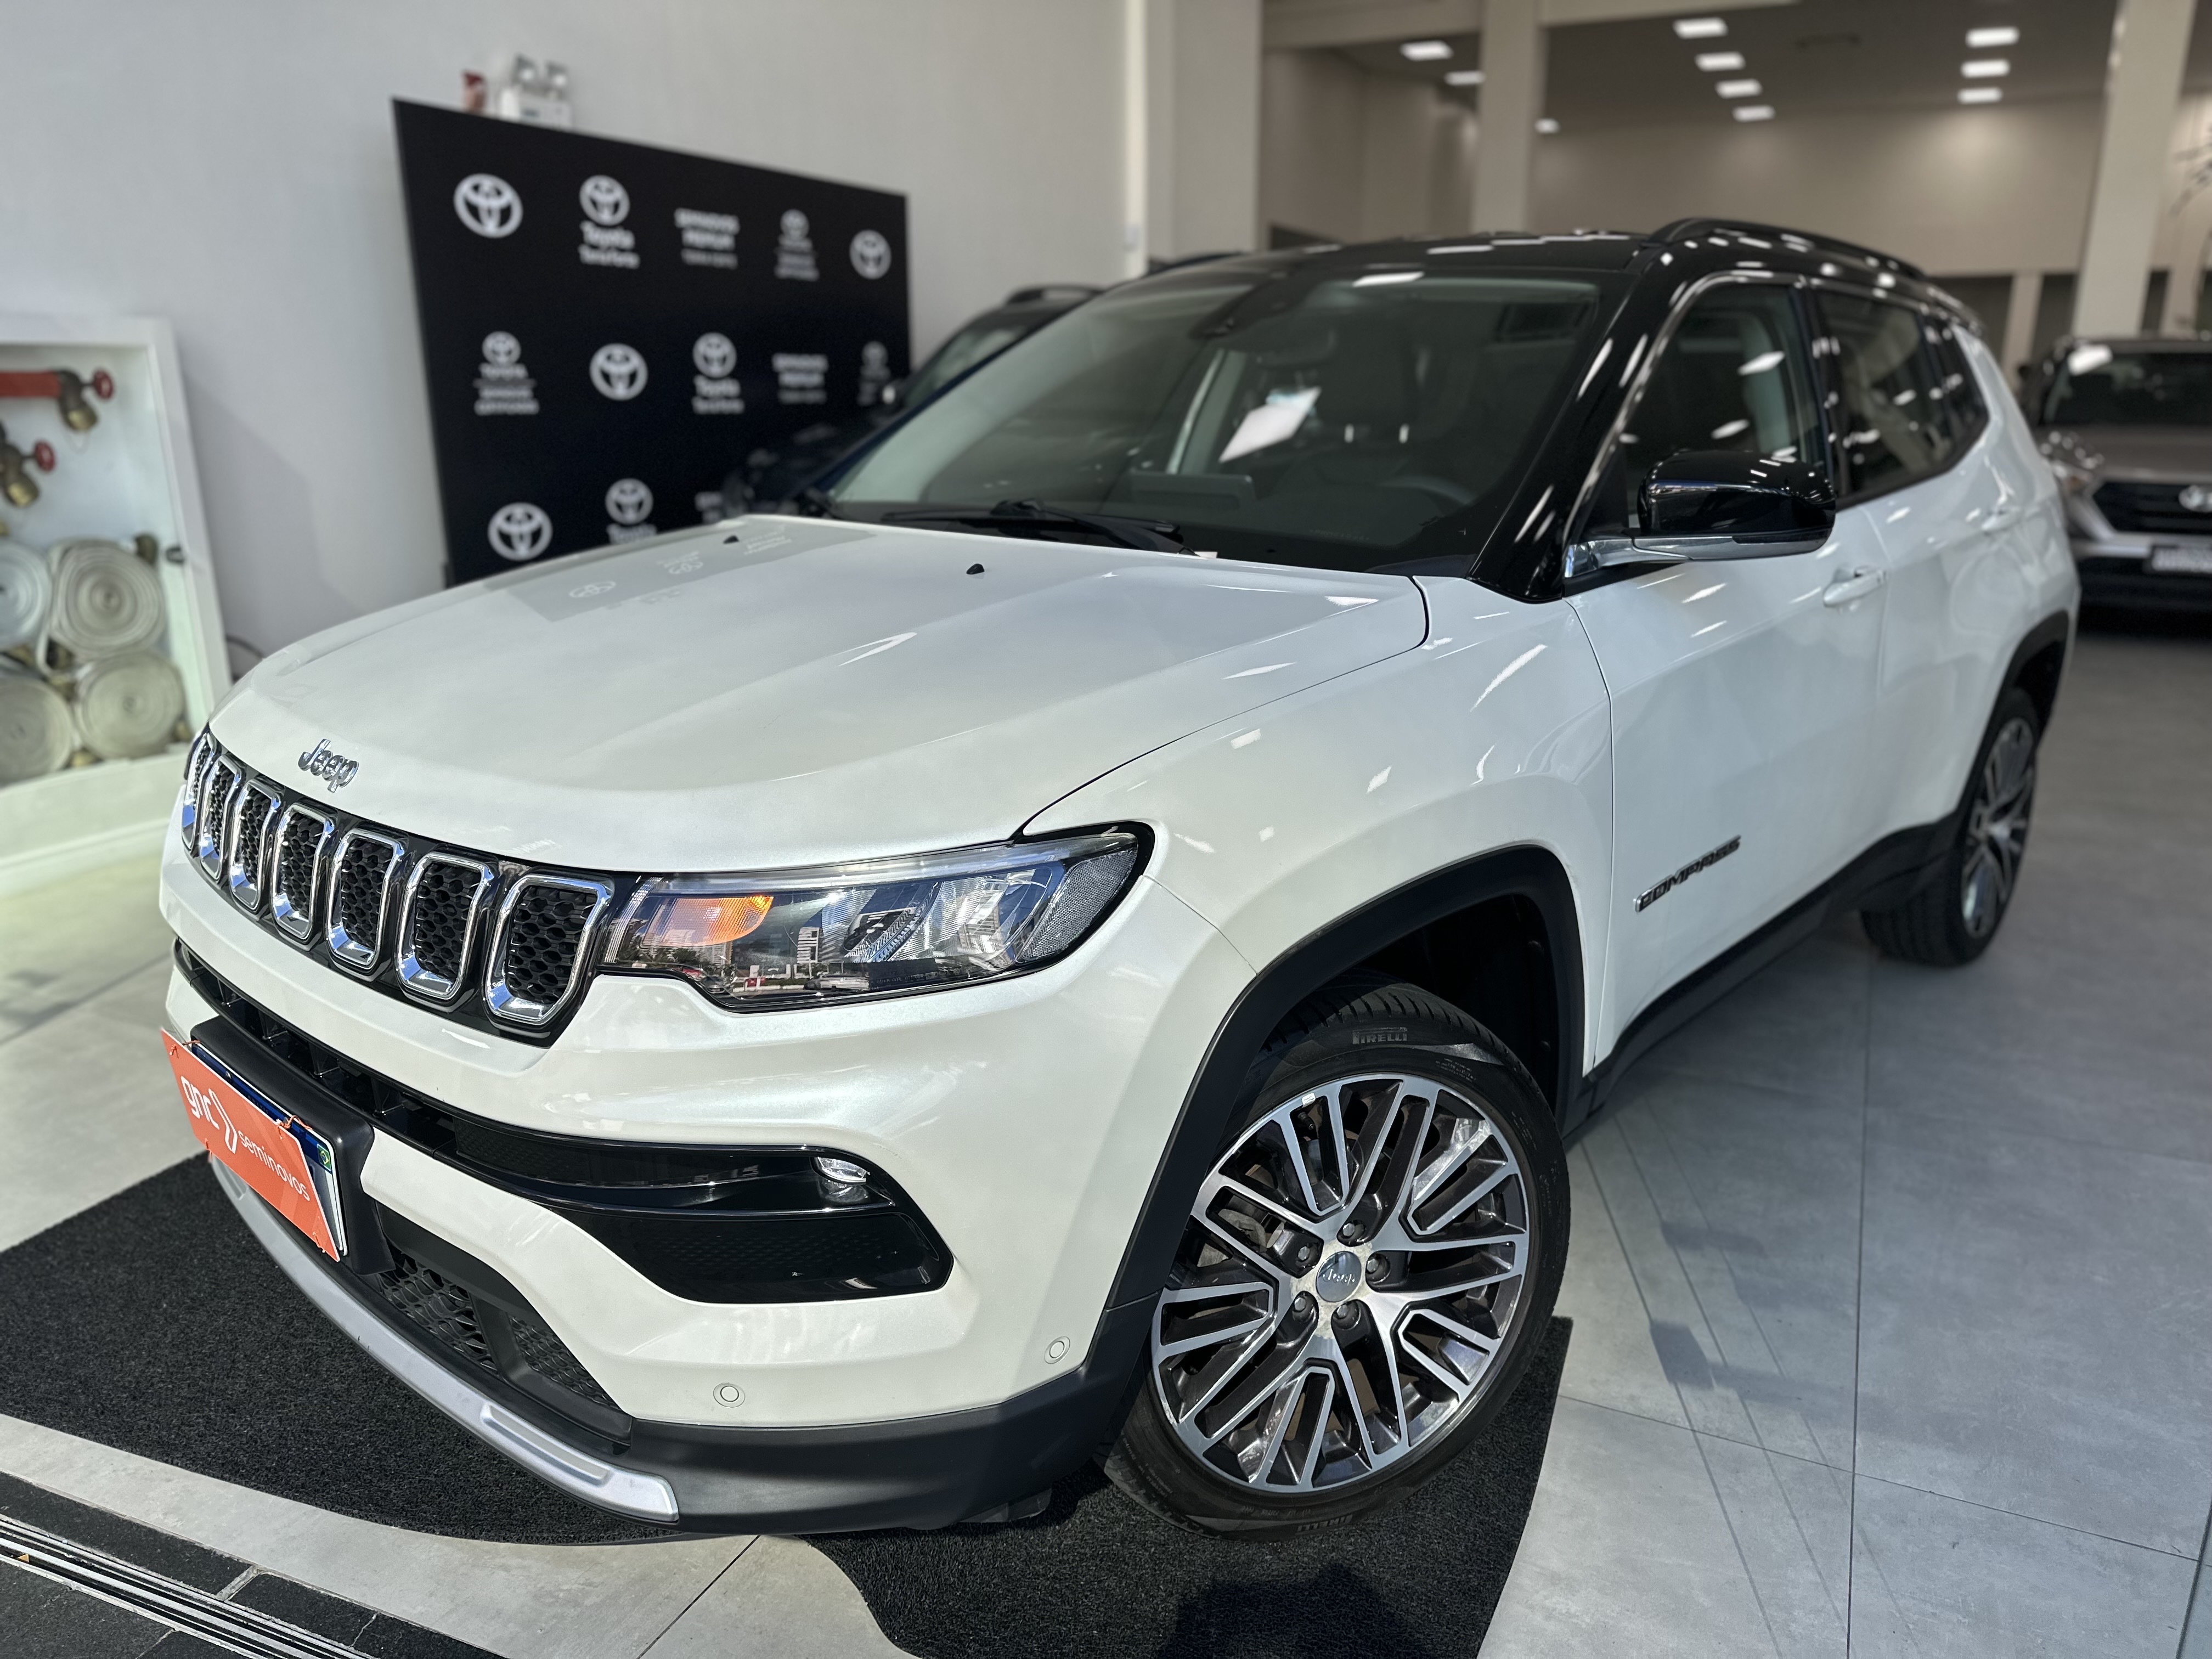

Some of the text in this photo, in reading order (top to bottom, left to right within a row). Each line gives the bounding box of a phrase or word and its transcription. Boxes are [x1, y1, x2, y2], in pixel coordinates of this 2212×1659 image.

[298, 738, 359, 793] Jeep
[1352, 1027, 1408, 1045] PIRELLI
[180, 1076, 220, 1130] gnc
[238, 1130, 311, 1201] seminovos
